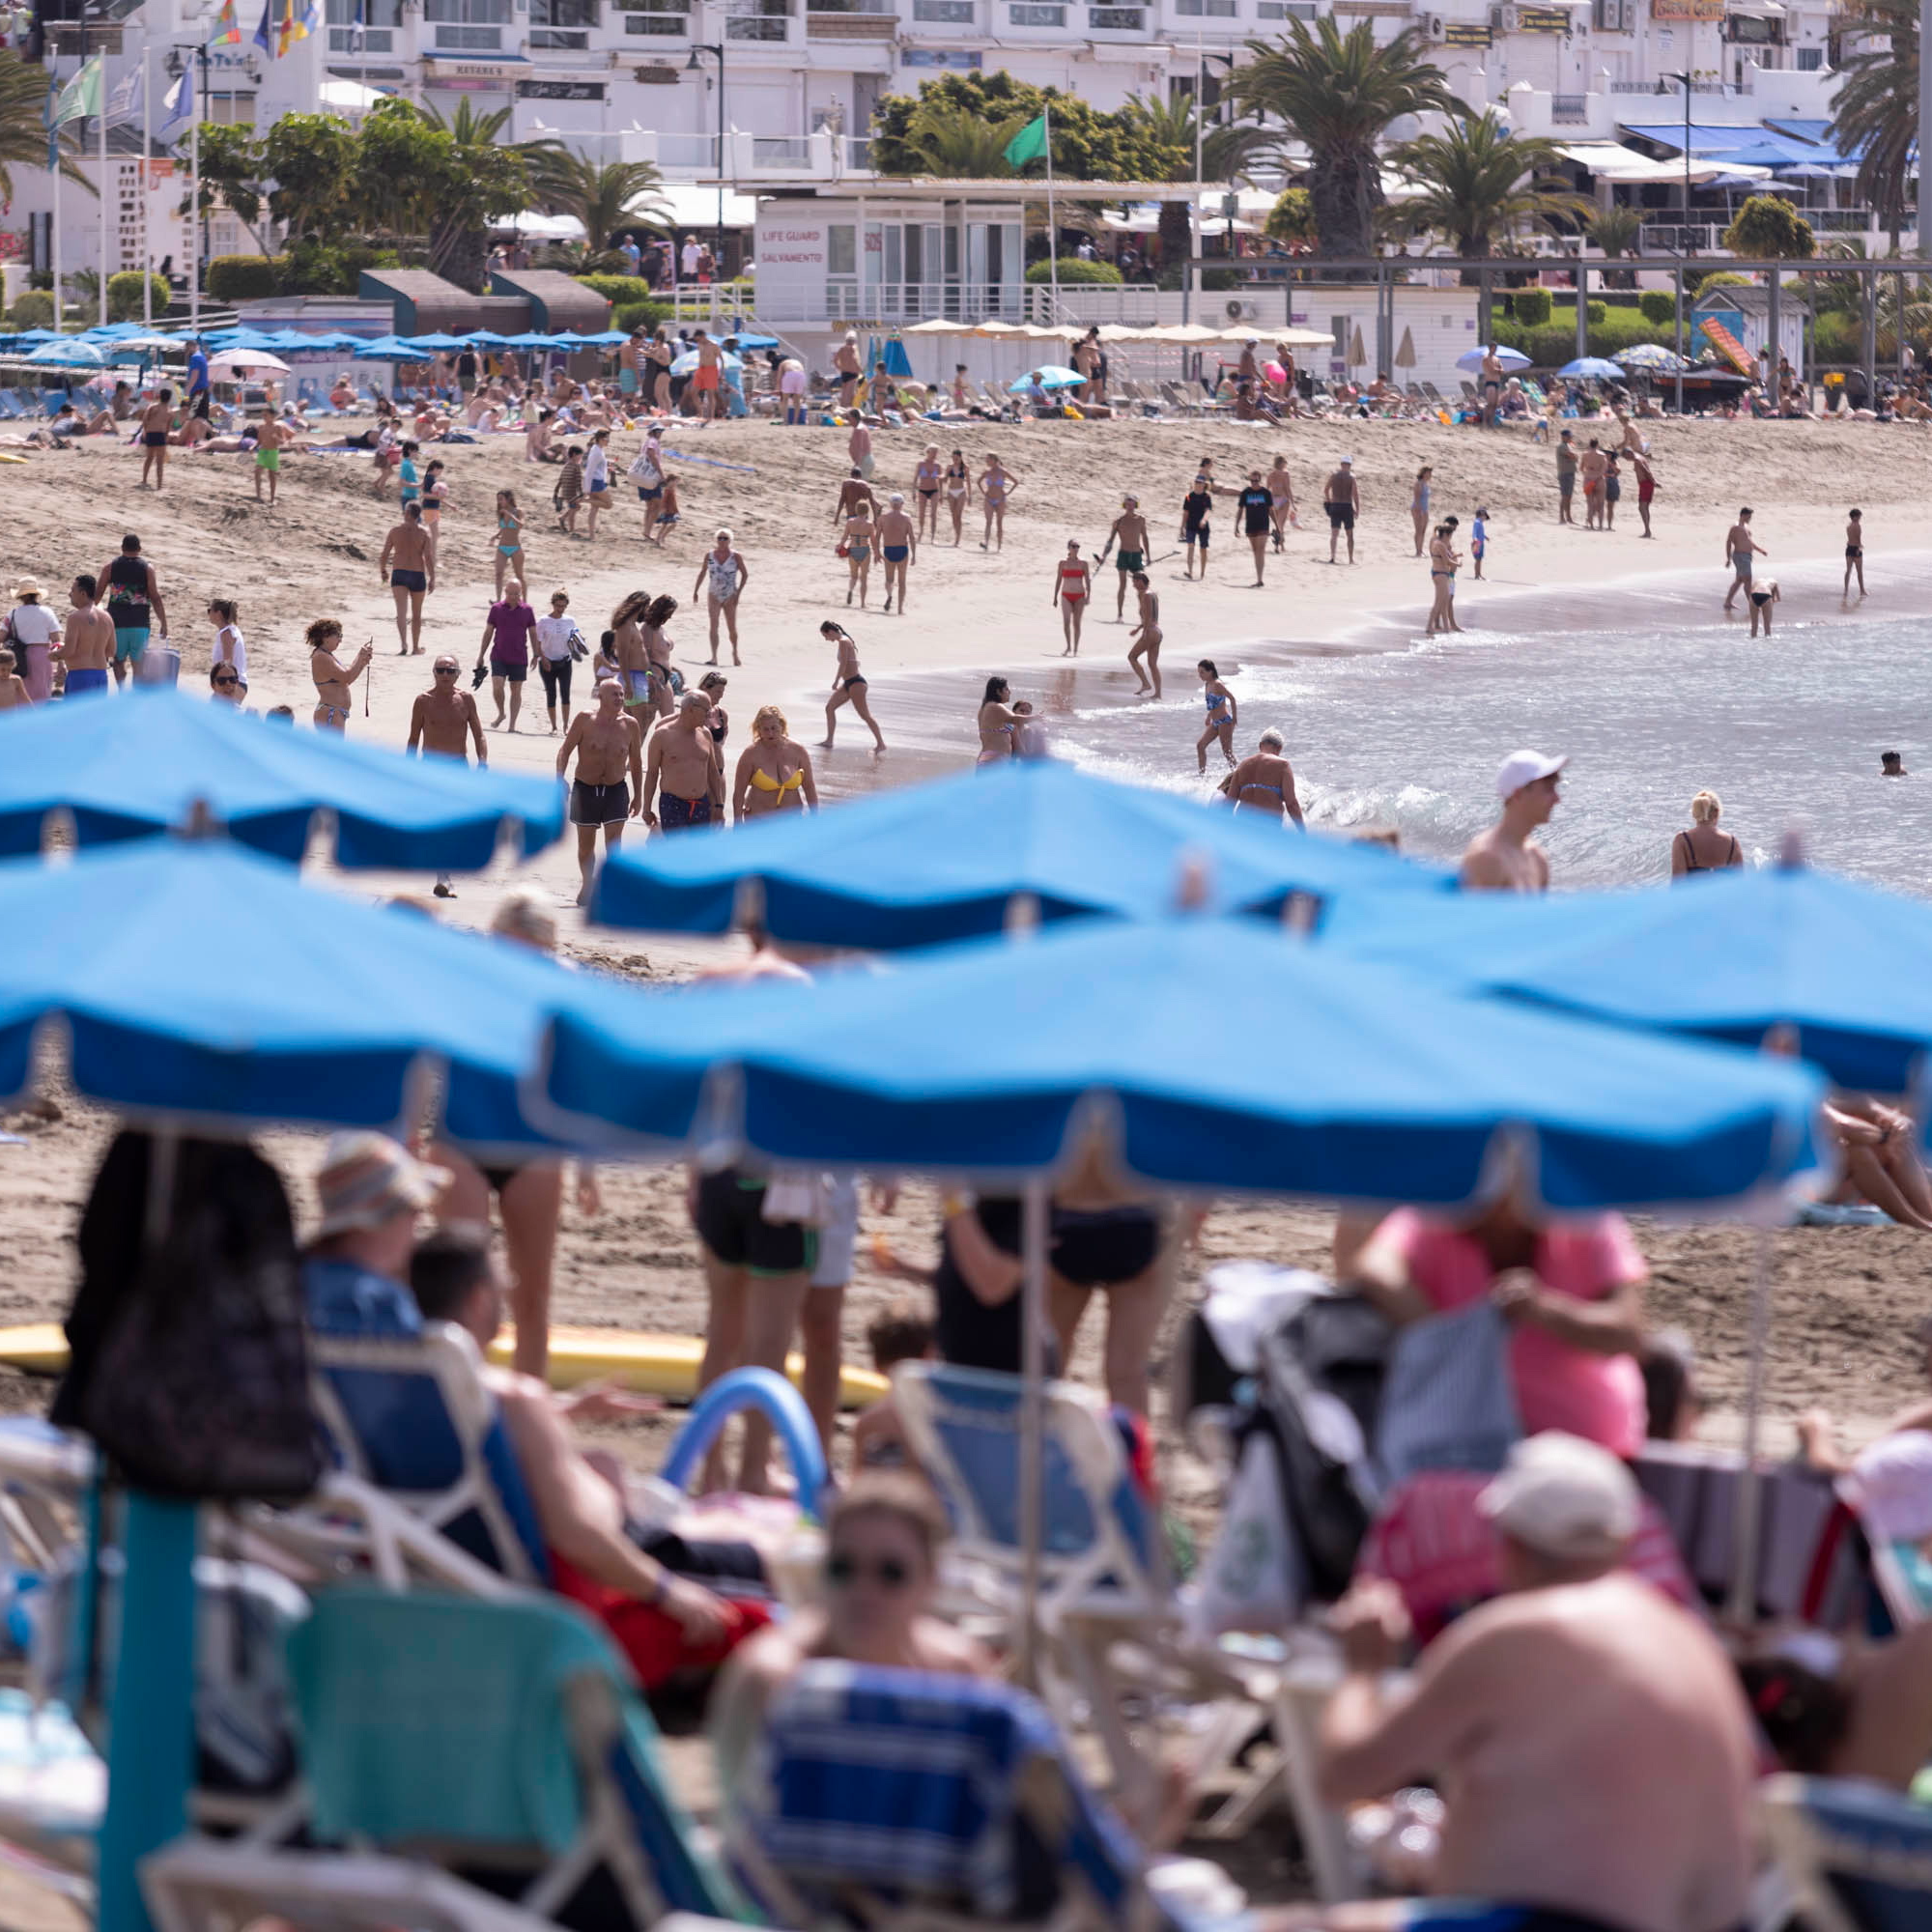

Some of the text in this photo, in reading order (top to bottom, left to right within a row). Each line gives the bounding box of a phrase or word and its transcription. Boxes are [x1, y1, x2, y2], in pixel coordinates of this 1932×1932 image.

[762, 231, 820, 242] LIFE GUARD
[761, 253, 823, 263] SALVAMENTO
